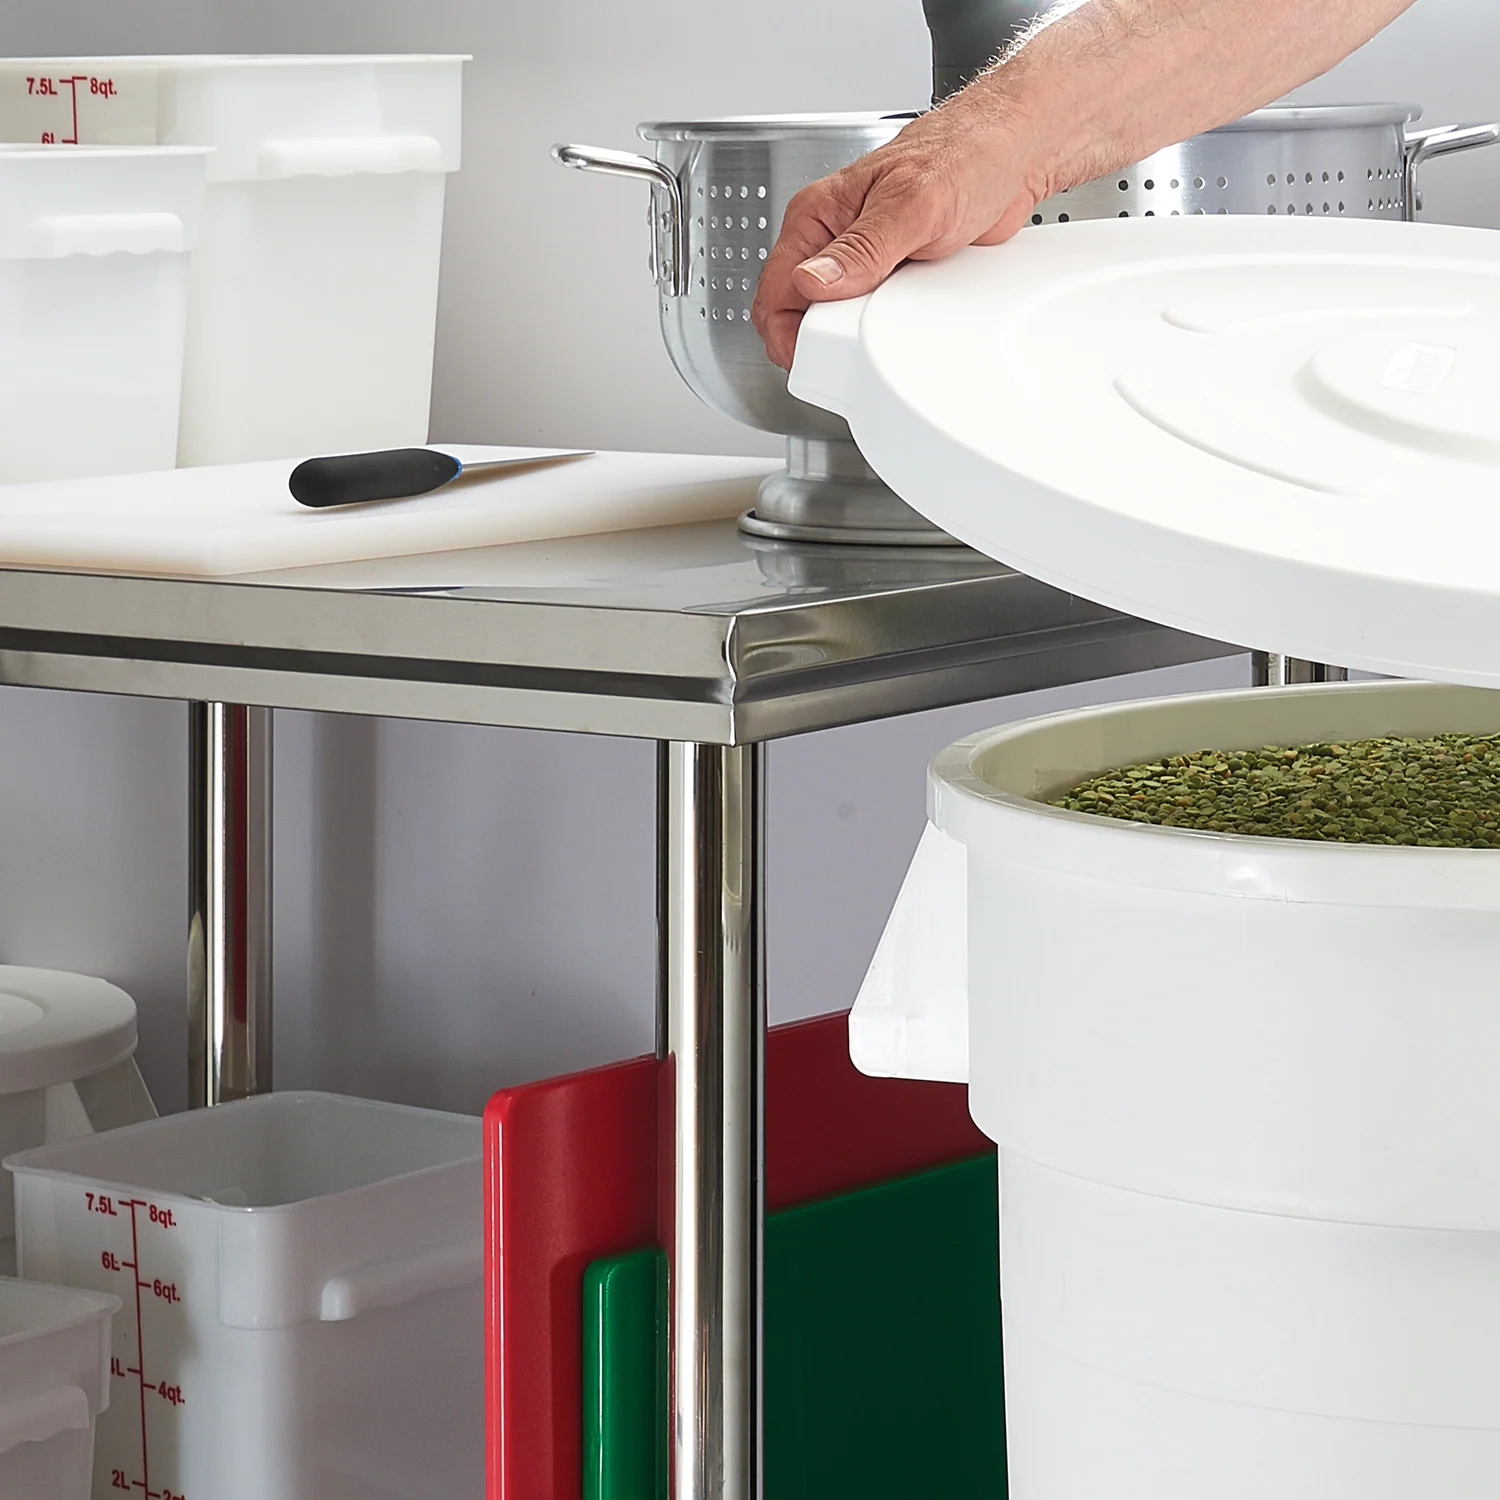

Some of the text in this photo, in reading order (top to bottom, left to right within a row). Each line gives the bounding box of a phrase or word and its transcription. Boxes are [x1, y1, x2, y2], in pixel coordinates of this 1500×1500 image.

[26, 76, 118, 99] 7.5L 8qt.
[85, 1191, 177, 1230] 7.5L 8qt.
[101, 1250, 121, 1272] 6L
[153, 1278, 182, 1303] 6qt.
[158, 1381, 186, 1406] 4qt.
[111, 1470, 131, 1491] 2L
